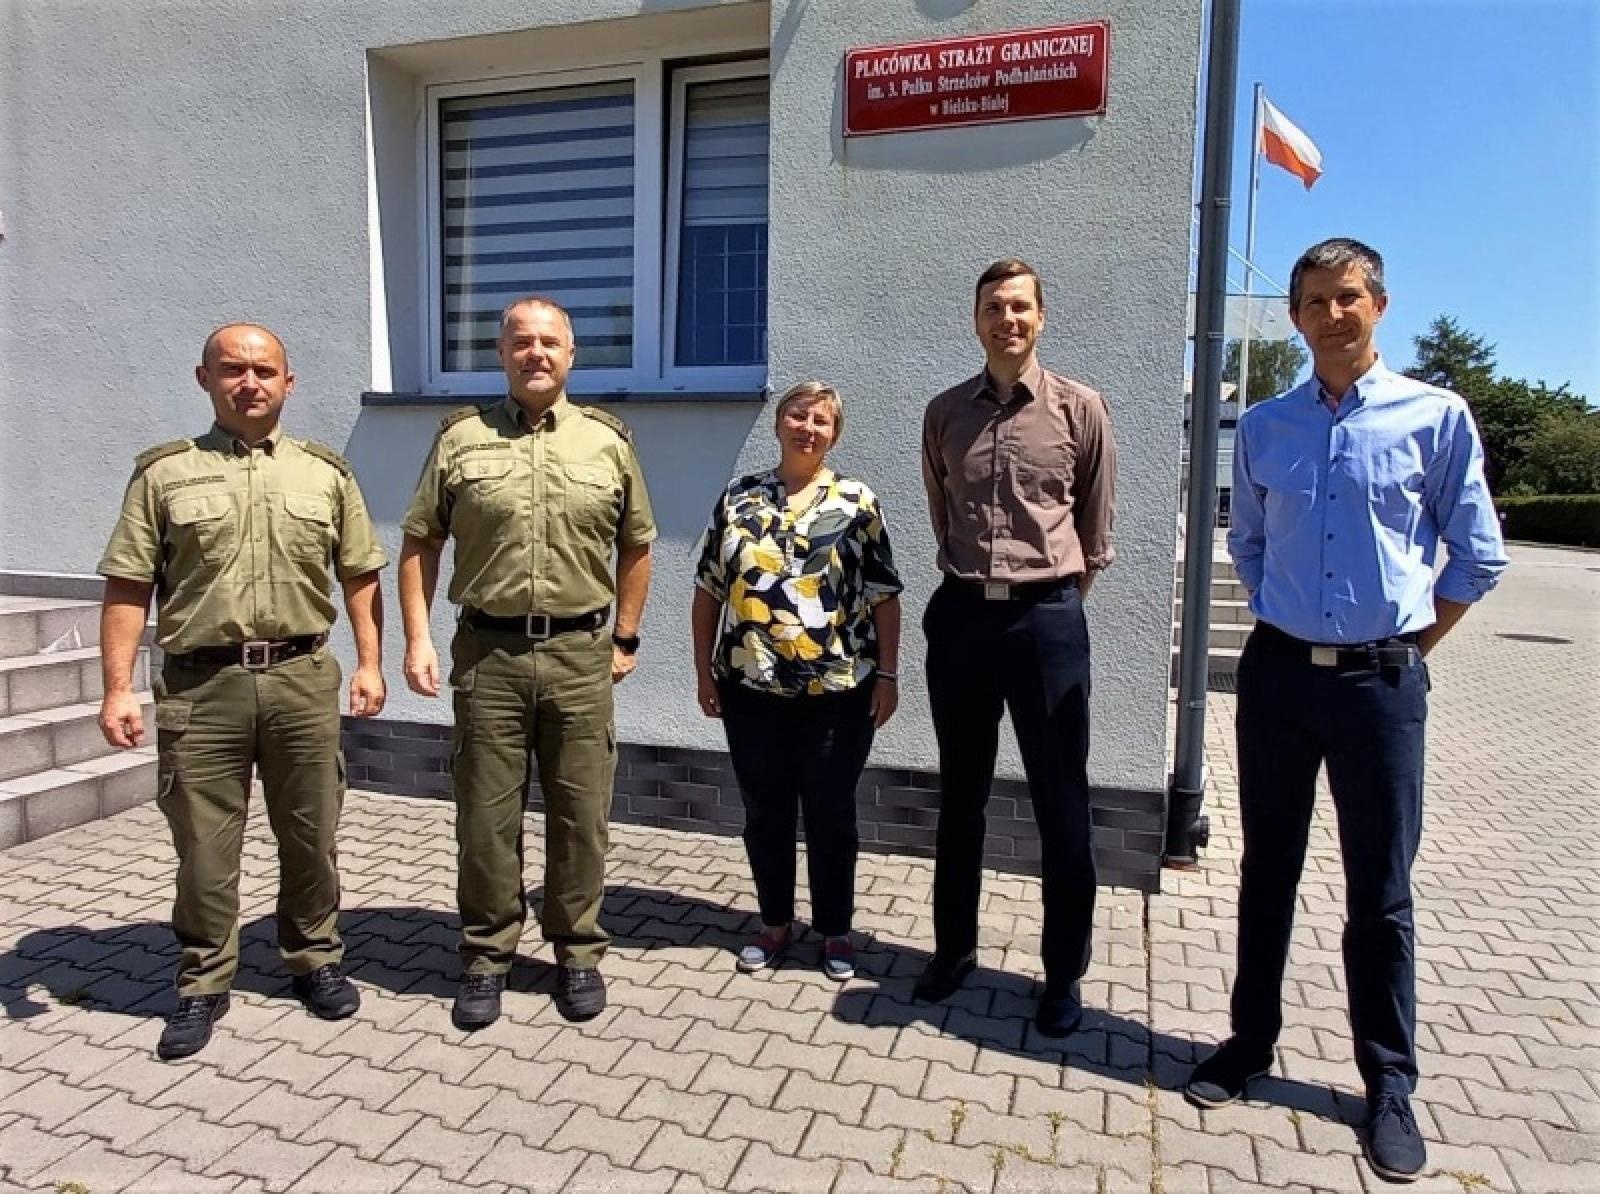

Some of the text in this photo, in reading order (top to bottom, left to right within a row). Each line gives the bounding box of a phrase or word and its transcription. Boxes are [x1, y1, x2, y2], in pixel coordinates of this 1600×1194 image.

[855, 34, 1095, 78] PLACÓWKA STRAŻY GRANICZNEJ
